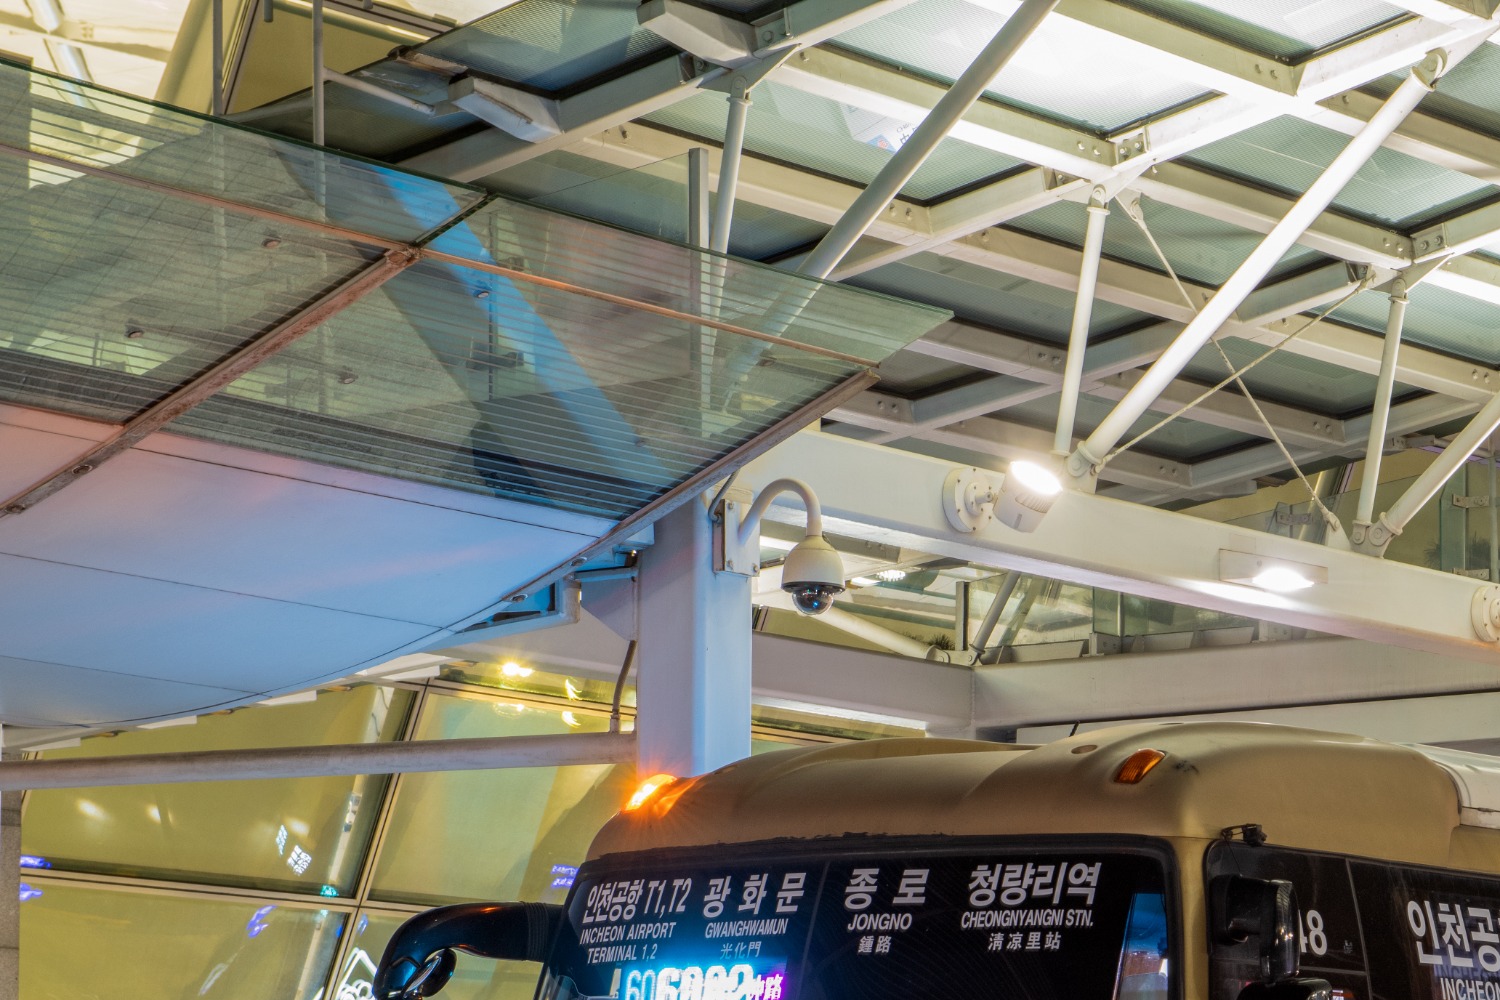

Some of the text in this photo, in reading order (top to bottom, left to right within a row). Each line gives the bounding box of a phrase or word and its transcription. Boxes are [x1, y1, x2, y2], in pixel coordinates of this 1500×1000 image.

[968, 862, 1102, 907] 청량리역
[582, 878, 692, 924] 인천공항 T1,T2
[705, 919, 789, 938] GWANGHWAMUN
[847, 913, 912, 931] JONGNO
[961, 909, 1094, 929] CHEONGNYANGNI STN.
[580, 922, 676, 944] INCHEON AIRPORT
[587, 944, 657, 963] TERMINAL 1,2
[720, 941, 762, 960] 光化門
